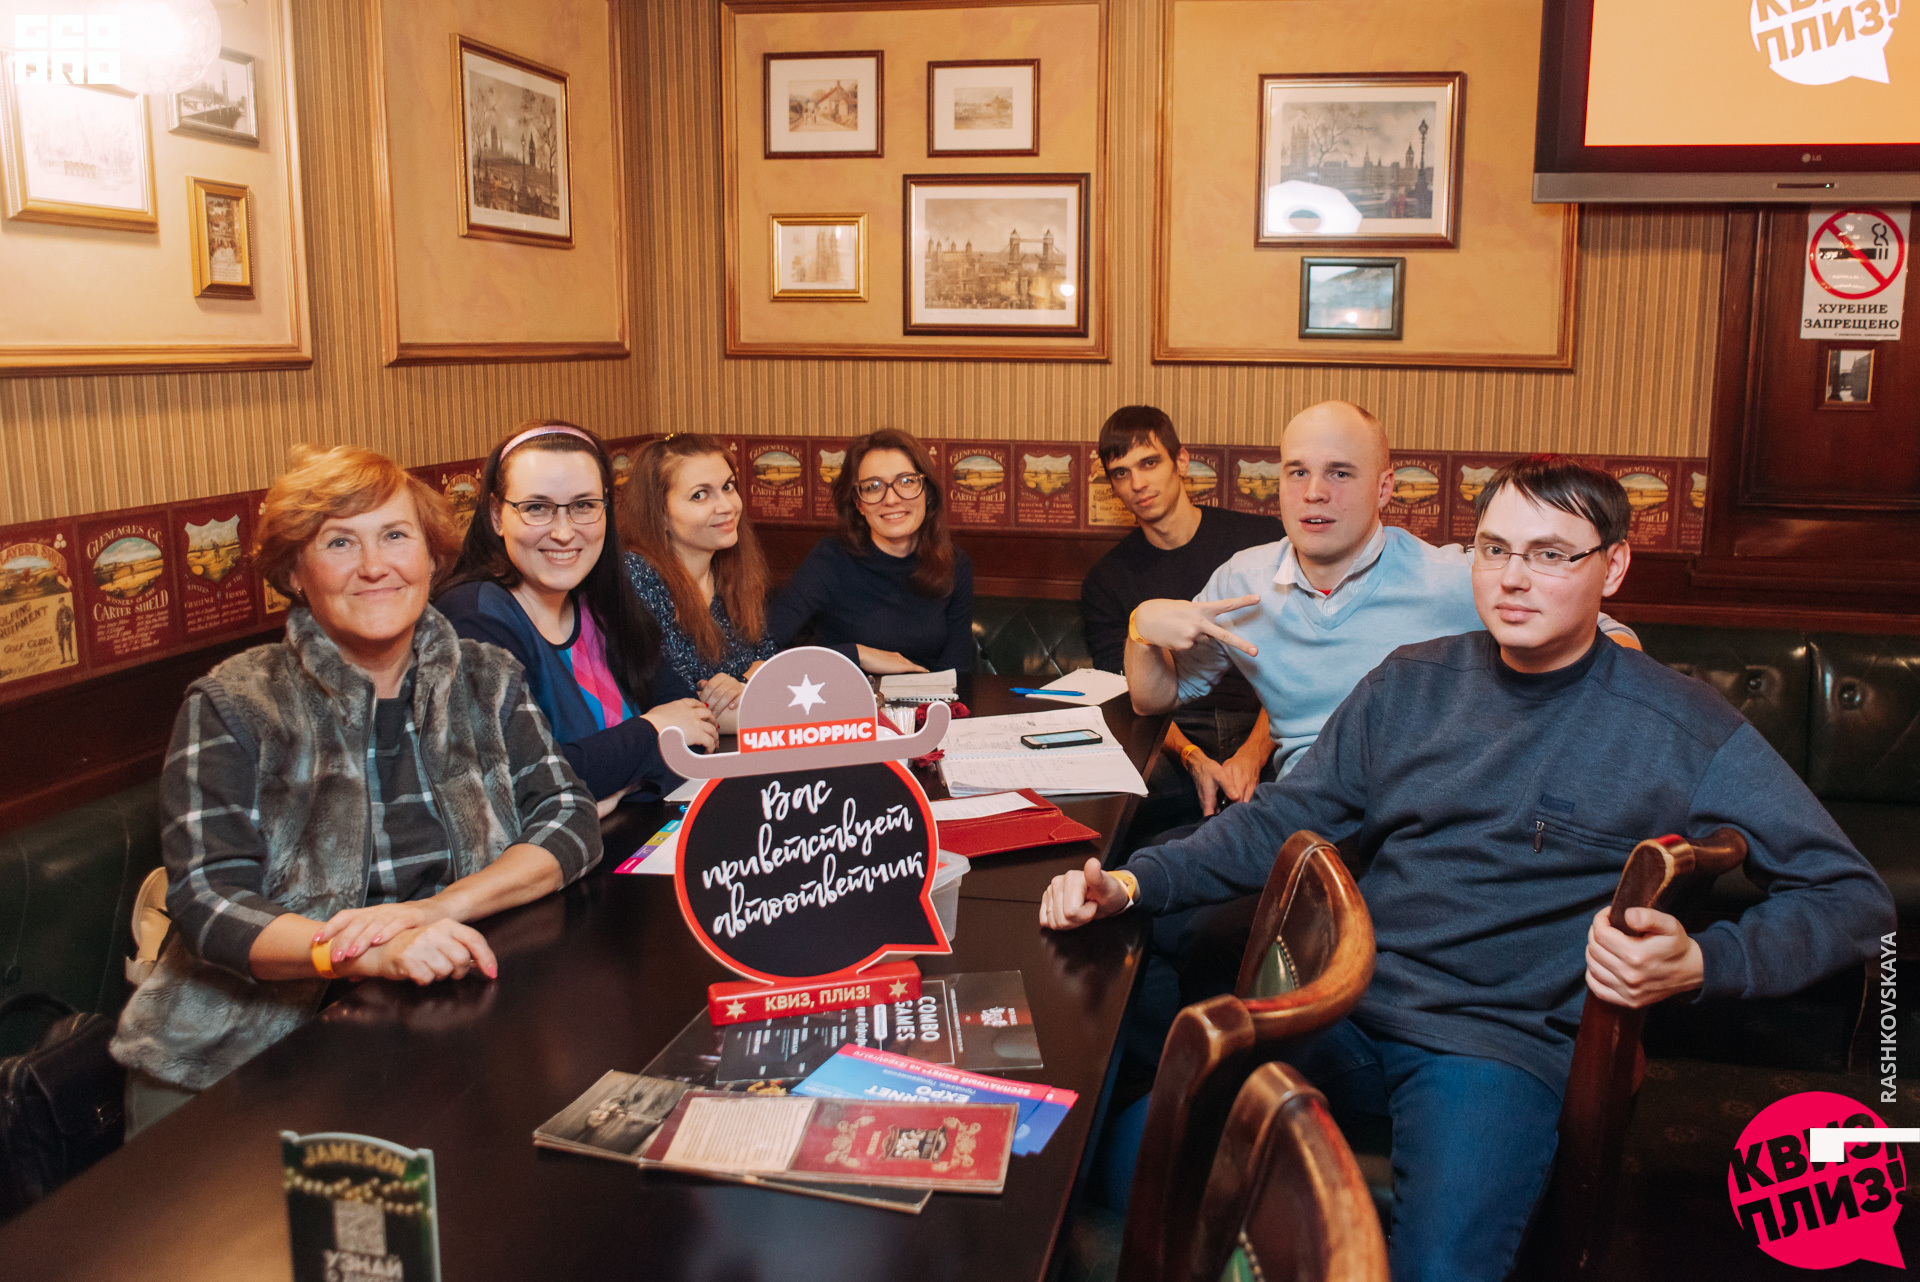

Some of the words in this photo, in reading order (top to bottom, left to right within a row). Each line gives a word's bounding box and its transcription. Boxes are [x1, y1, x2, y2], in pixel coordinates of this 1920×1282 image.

[1804, 318, 1900, 330] ЗАПРЕЩЕНО
[1818, 304, 1888, 314] КУРЕНИЕ
[950, 489, 977, 502] CARTER
[979, 491, 1006, 502] SHIELD
[86, 525, 144, 560] GLENEAGLES
[0, 602, 32, 627] OLFING
[93, 602, 132, 622] CARTER
[135, 589, 169, 613] SHIELD
[0, 605, 49, 640] QUIPMENT
[4, 643, 25, 654] GOLF
[743, 730, 785, 749] ЧАК
[788, 722, 872, 746] НОРРИС
[761, 780, 832, 821] Вас
[702, 798, 913, 890] приветствует
[713, 852, 925, 938] автоответчик
[765, 995, 815, 1012] КВИЗ,
[819, 985, 871, 1004] ПЛИЗ!
[895, 1001, 916, 1042] GAMES
[918, 996, 940, 1042] COMBO
[916, 1085, 970, 1104] EXPO
[959, 1075, 1031, 1096] БЕСПЛАТНЫЙ
[303, 1143, 407, 1178] JAMESON
